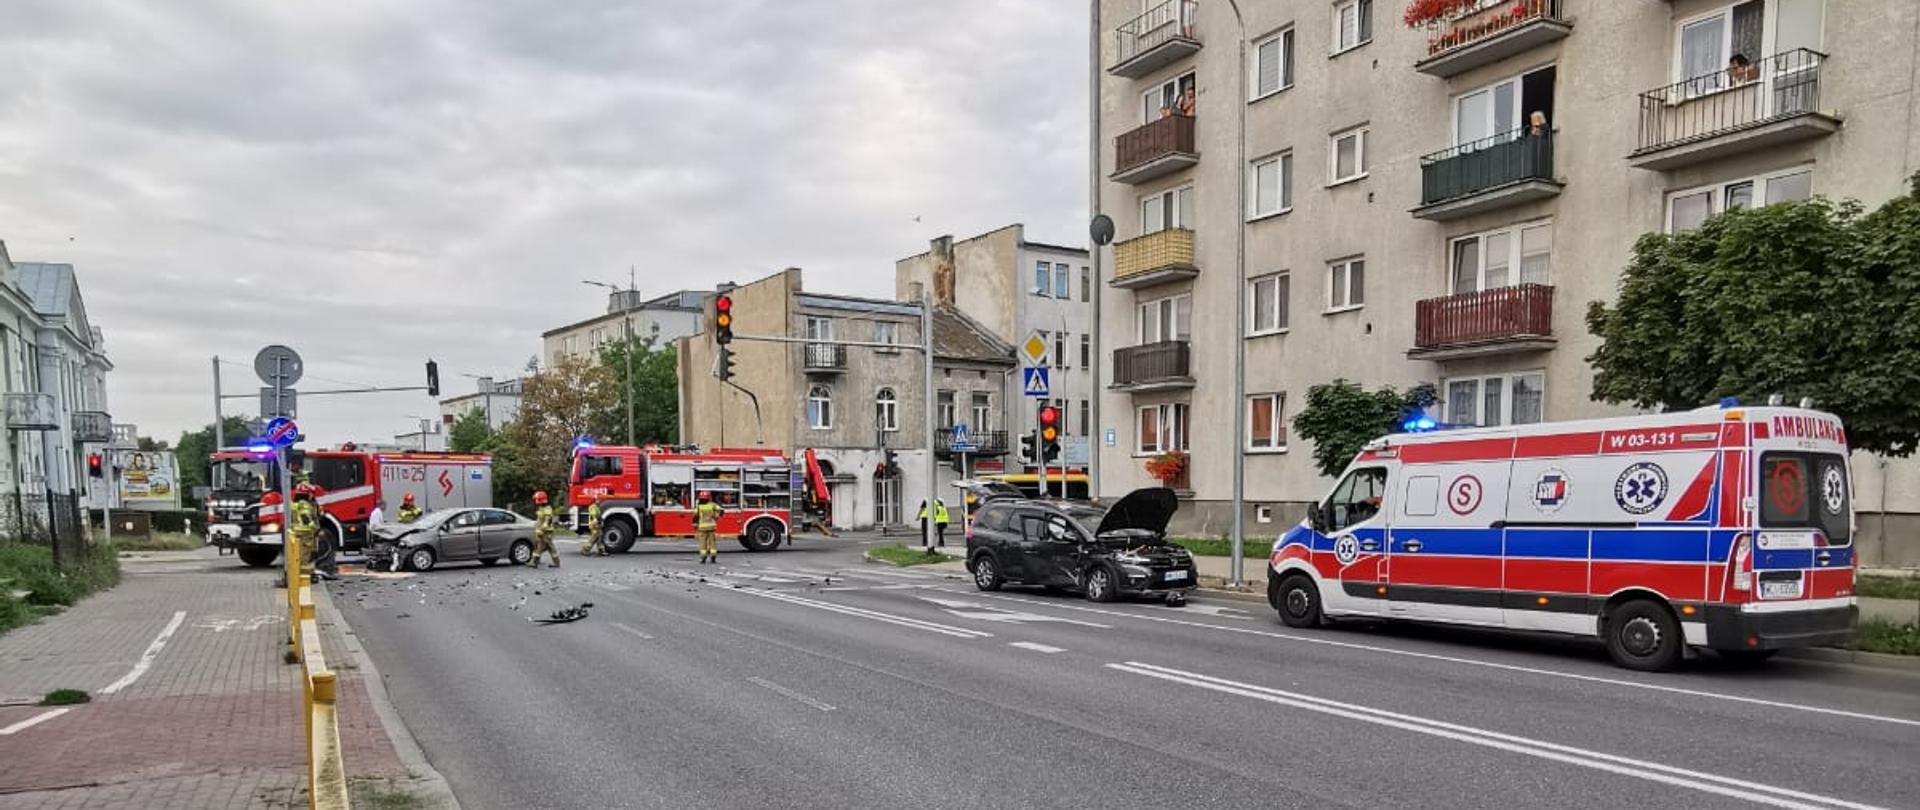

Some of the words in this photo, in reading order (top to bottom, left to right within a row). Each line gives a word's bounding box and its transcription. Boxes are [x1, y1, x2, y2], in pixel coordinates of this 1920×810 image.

[1611, 434, 1626, 447] W
[1628, 432, 1675, 447] 03-131
[411, 467, 425, 482] 25
[1457, 483, 1471, 506] S
